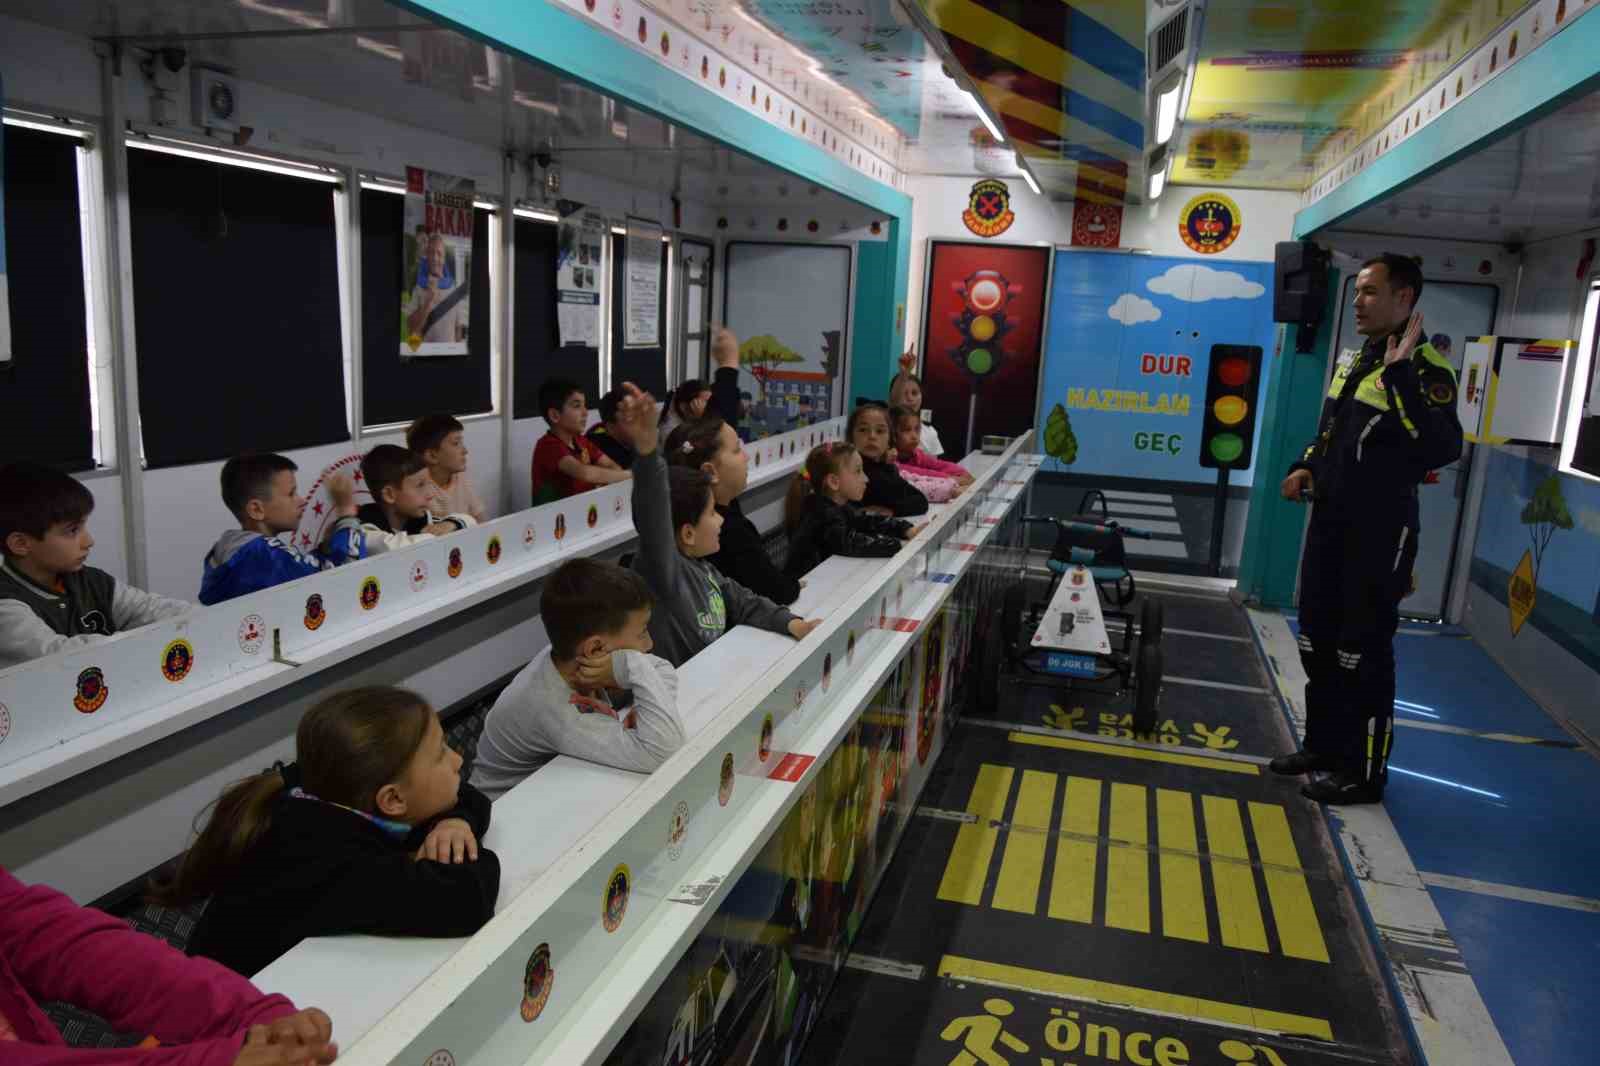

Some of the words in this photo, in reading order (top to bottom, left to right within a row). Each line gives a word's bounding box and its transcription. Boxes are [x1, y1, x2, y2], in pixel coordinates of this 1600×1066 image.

[1141, 353, 1191, 377] DUR
[1134, 431, 1182, 455] GEÇ
[1044, 1007, 1190, 1066] önce
